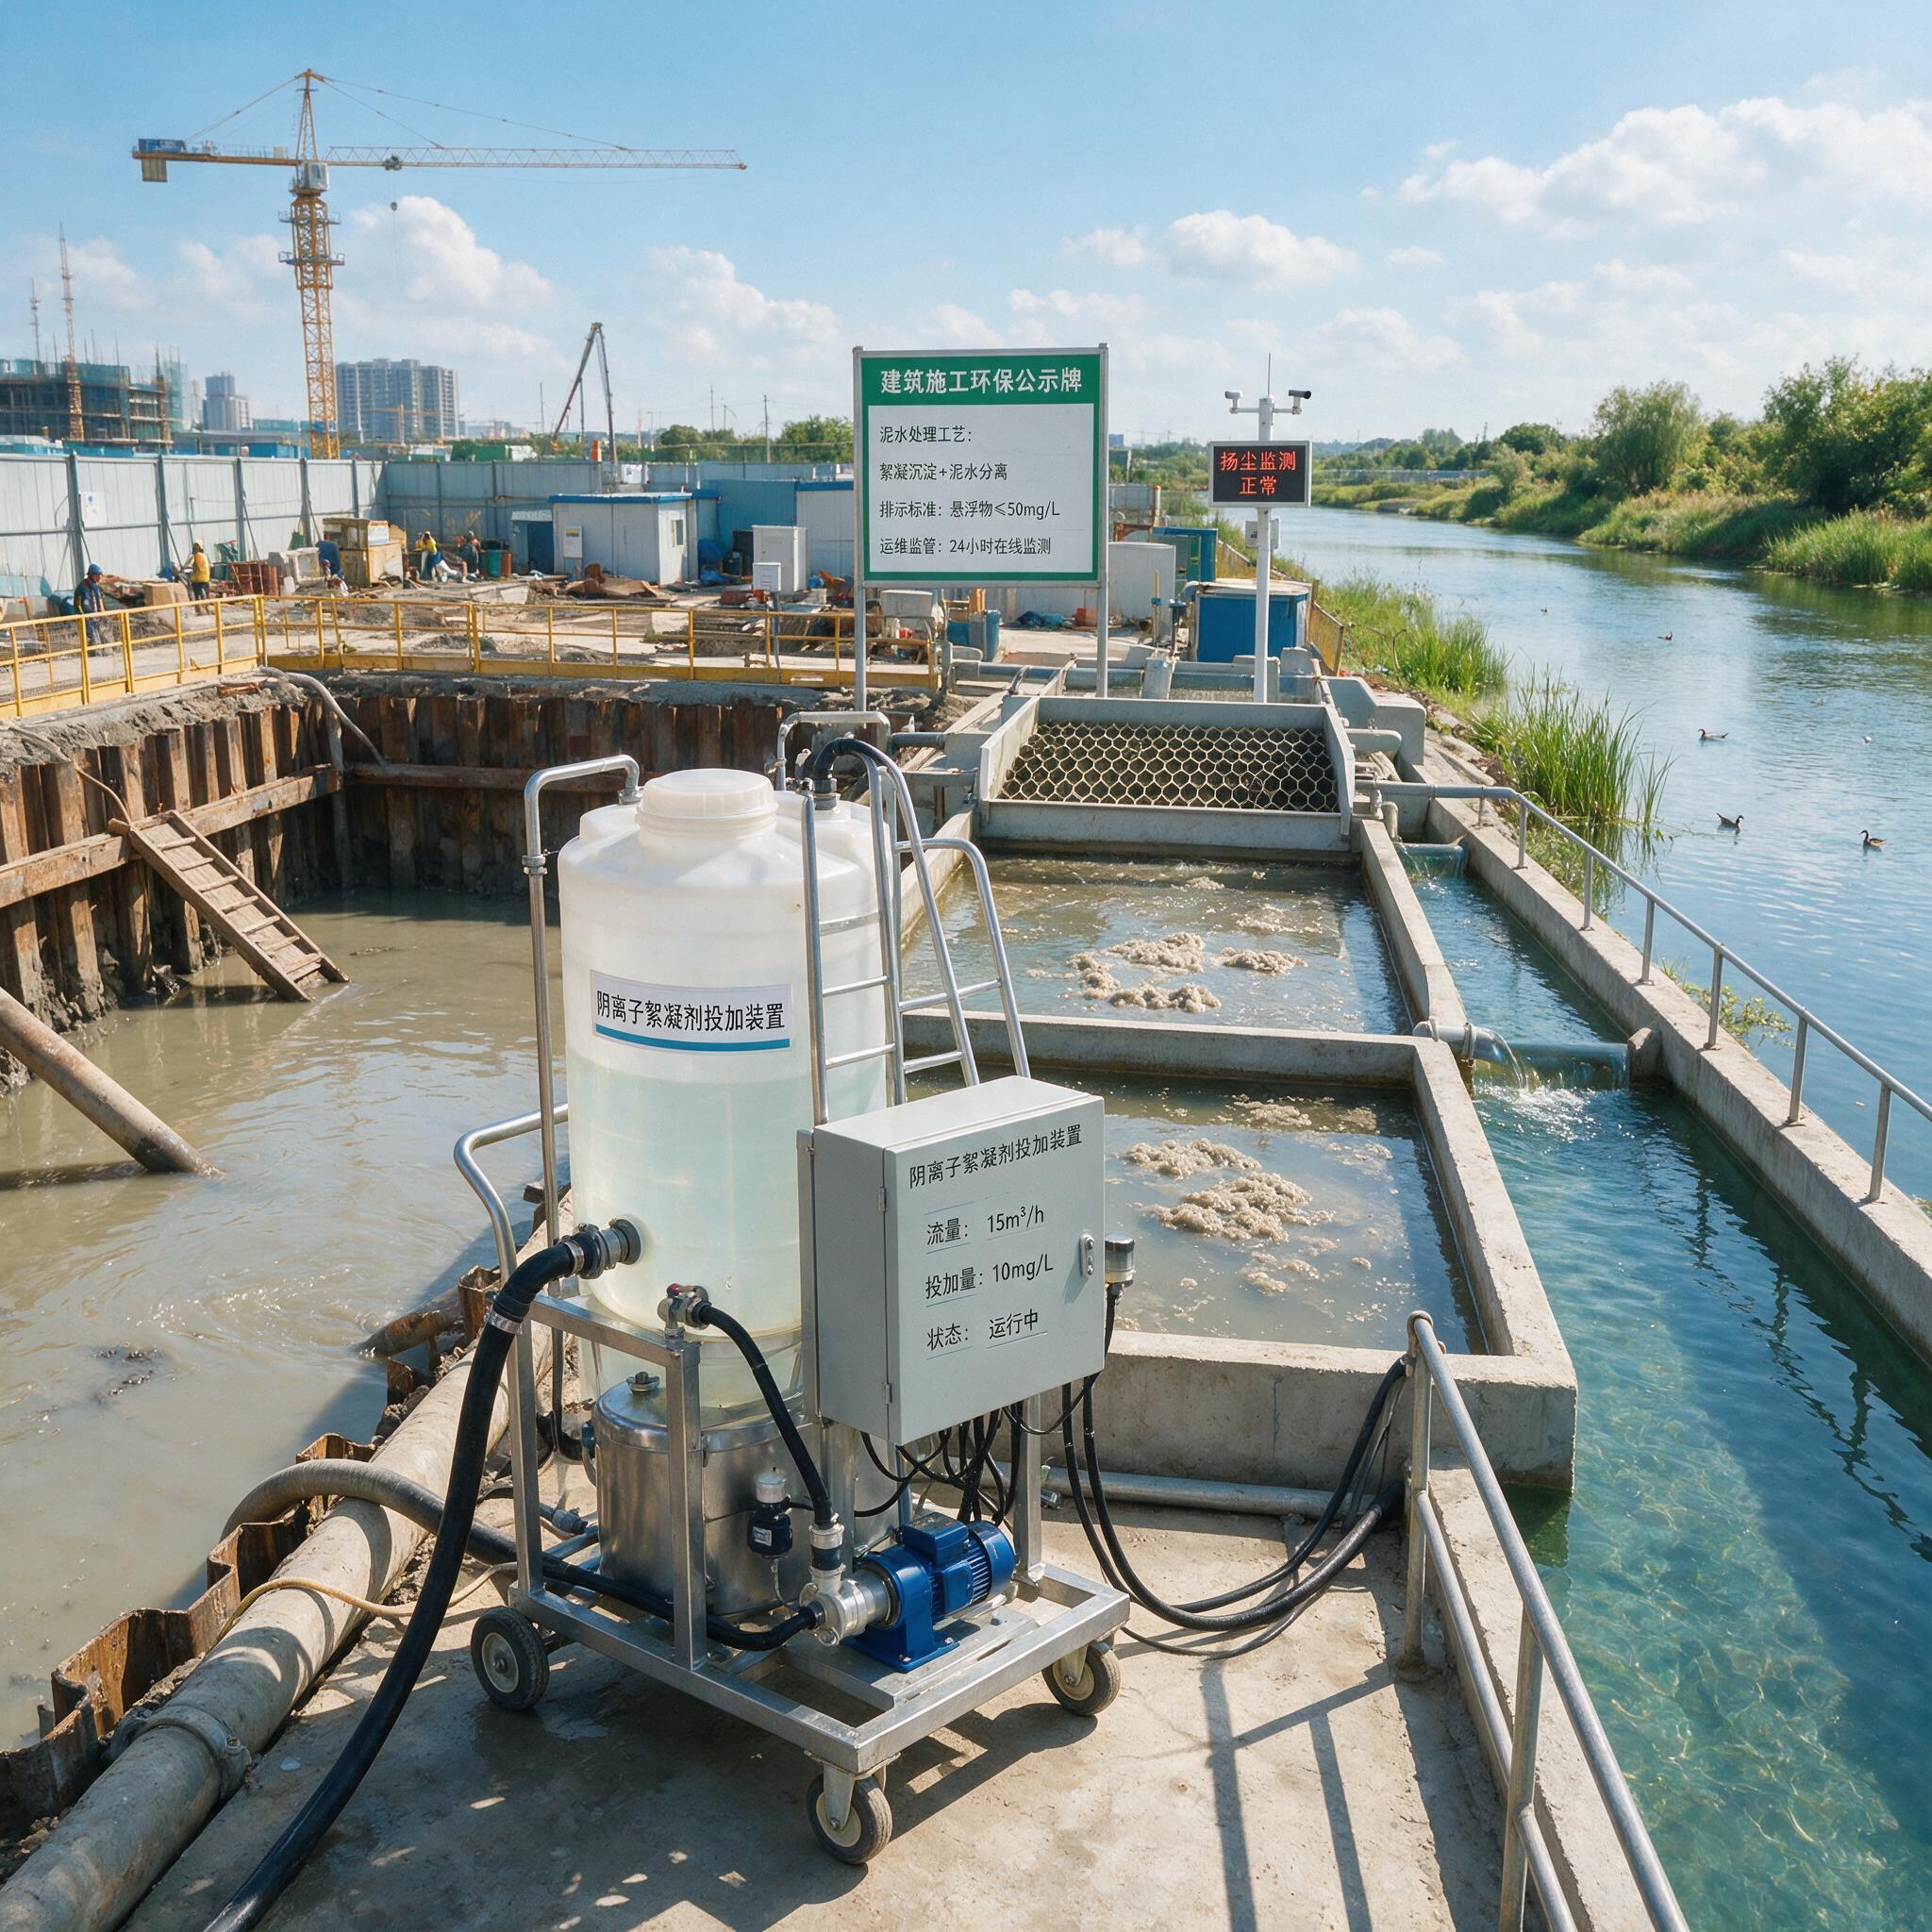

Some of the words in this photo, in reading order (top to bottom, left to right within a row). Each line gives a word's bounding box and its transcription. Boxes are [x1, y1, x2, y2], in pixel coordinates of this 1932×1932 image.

[881, 367, 1082, 393] 建筑施工环保公示牌
[879, 425, 972, 443] 泥水处理工艺：
[879, 462, 1008, 481] 絮凝沉淀+泥水分离
[1220, 451, 1296, 471] 扬尘监测
[1240, 475, 1277, 495] 正常
[596, 991, 785, 1031] 阴离子絮凝剂投加装置
[909, 1124, 1083, 1189] 阴离子絮凝剂投加装置
[926, 1217, 968, 1246] 流量：
[926, 1323, 969, 1352] 状态：
[989, 1308, 1039, 1341] 运行中
